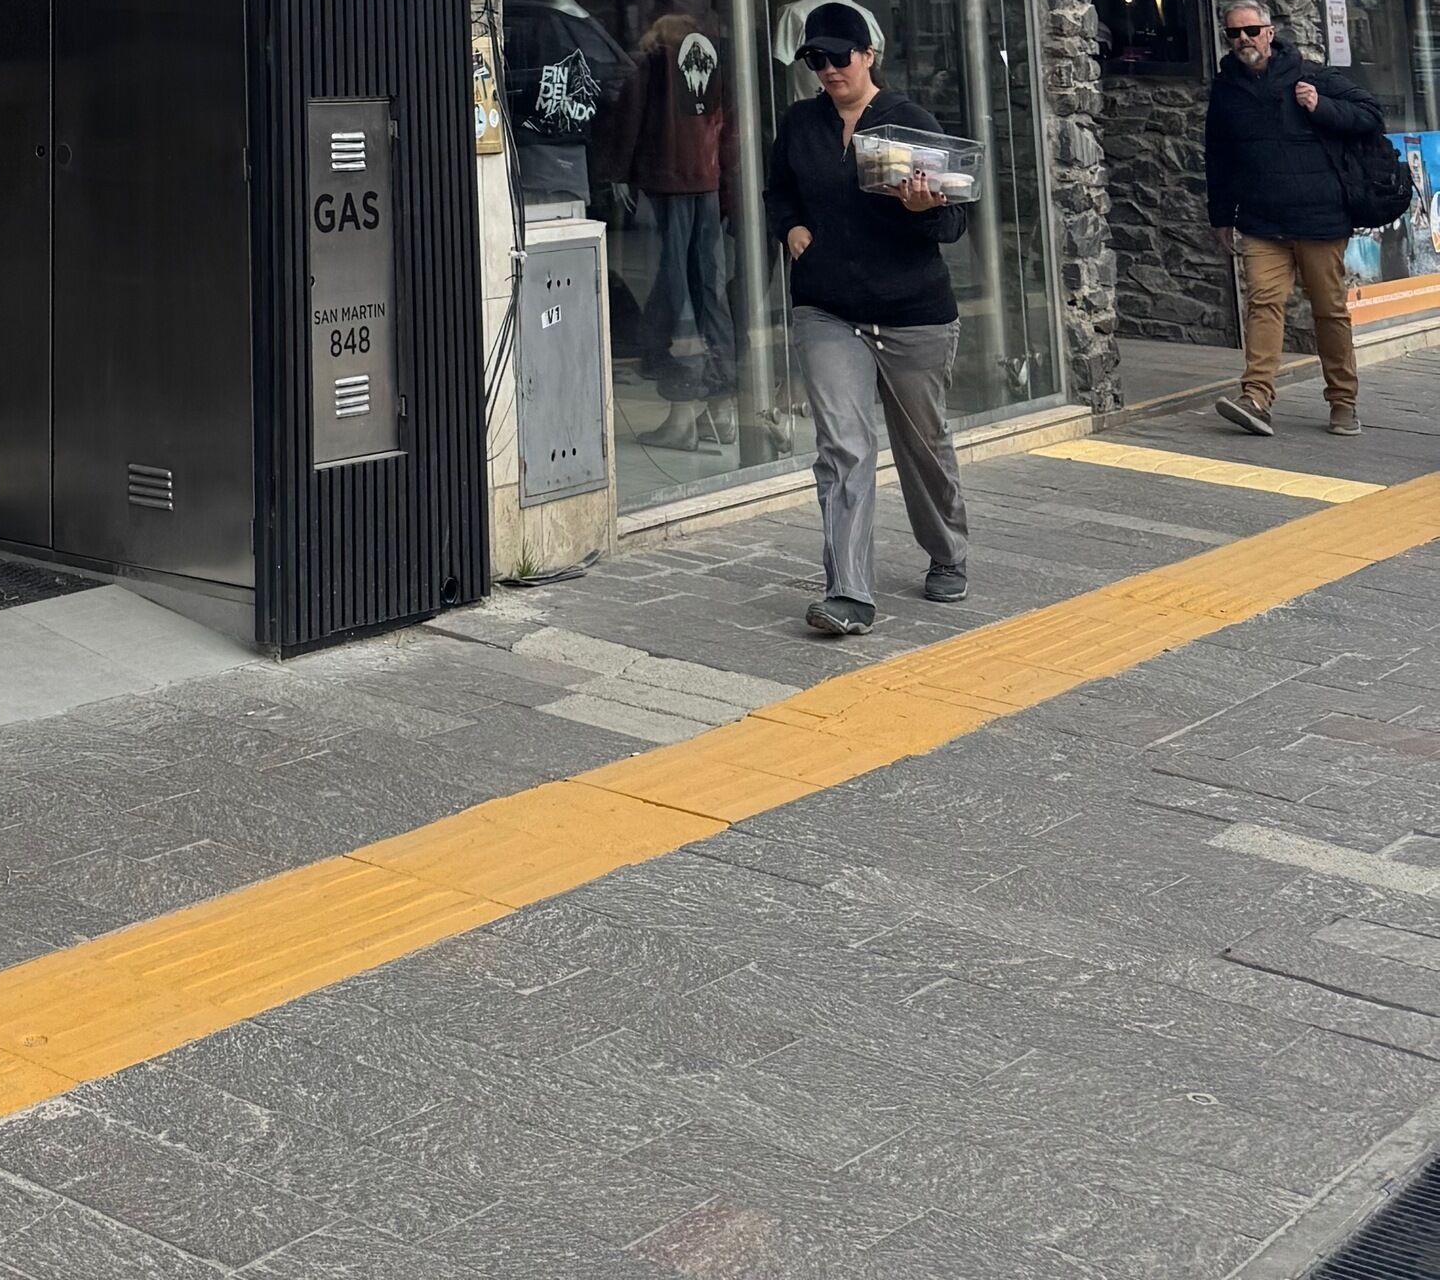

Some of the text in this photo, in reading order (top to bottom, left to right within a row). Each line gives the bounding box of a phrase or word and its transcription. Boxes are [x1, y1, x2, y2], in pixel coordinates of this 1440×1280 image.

[541, 65, 569, 84] FIN
[539, 81, 573, 101] DEL
[313, 190, 380, 234] GAS
[314, 302, 385, 325] SAN MARTIN
[330, 325, 371, 358] 848
